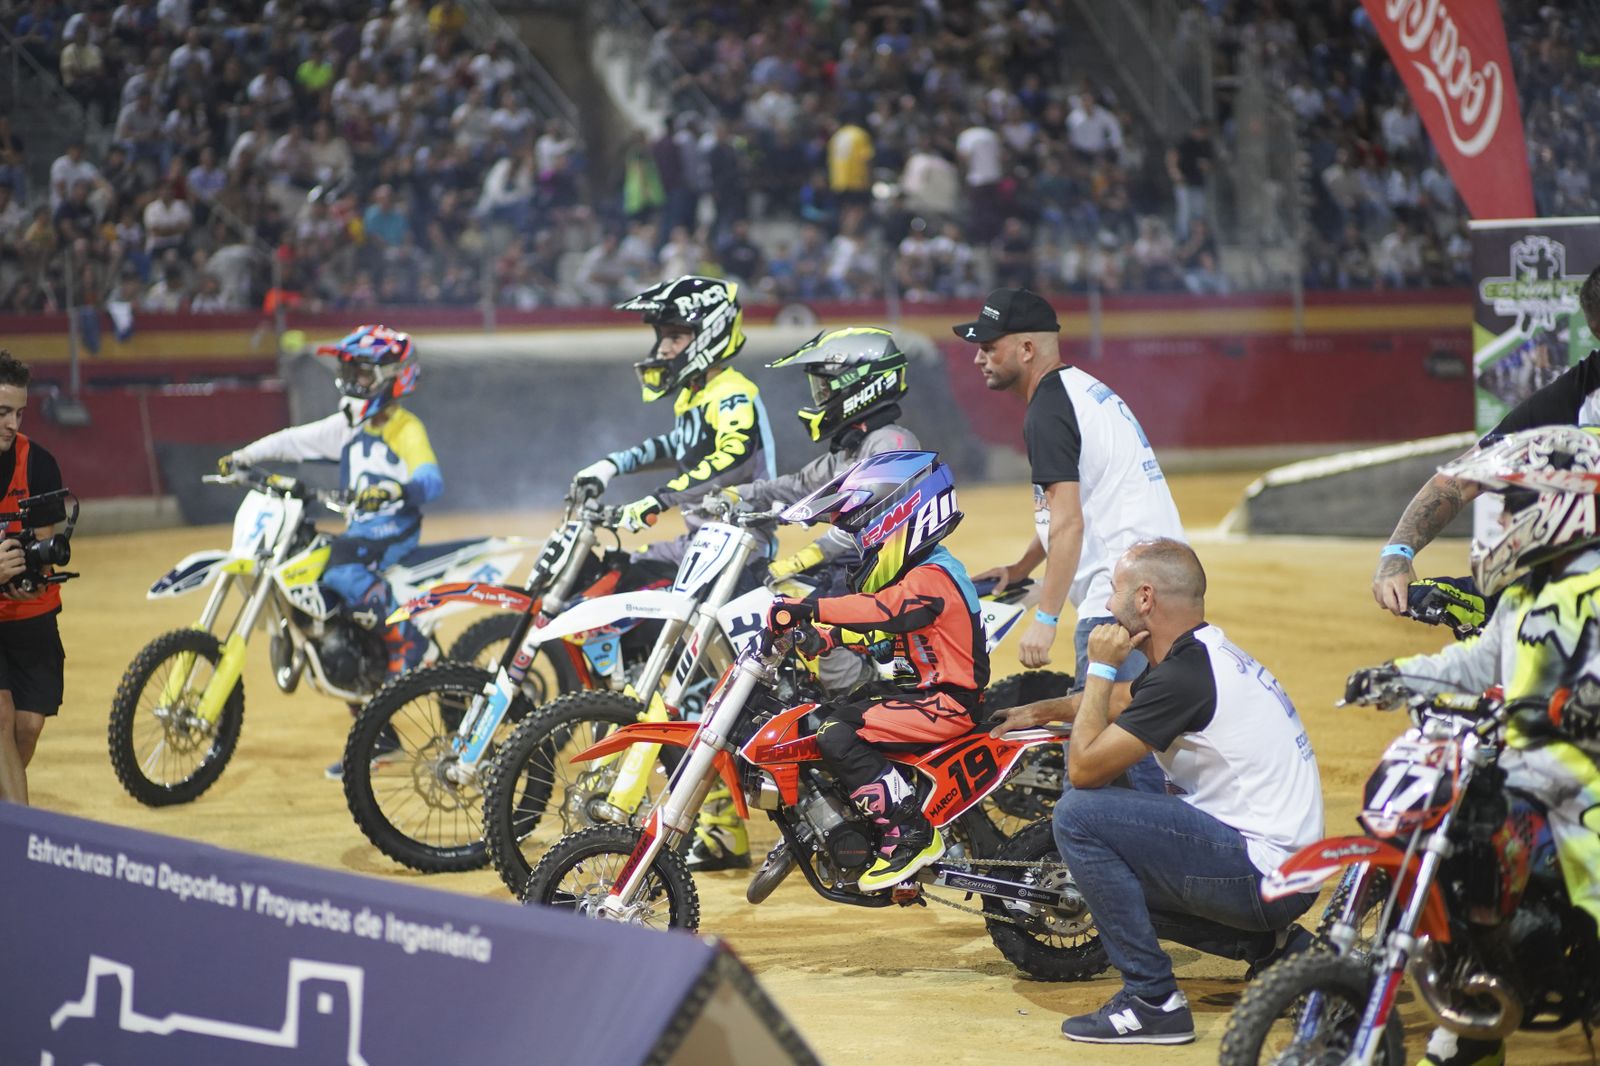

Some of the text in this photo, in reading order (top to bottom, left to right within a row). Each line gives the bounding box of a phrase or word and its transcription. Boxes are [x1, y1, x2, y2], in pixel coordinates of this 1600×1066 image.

[861, 489, 921, 549] FMF
[929, 788, 959, 818] MARCO
[948, 744, 999, 803] 19
[1368, 761, 1441, 813] 17
[27, 833, 113, 878] Estructuras
[115, 852, 155, 887] Para
[157, 862, 236, 907] Deportes
[240, 880, 255, 911] Y
[256, 886, 352, 934] Proyectos
[353, 906, 383, 940] de
